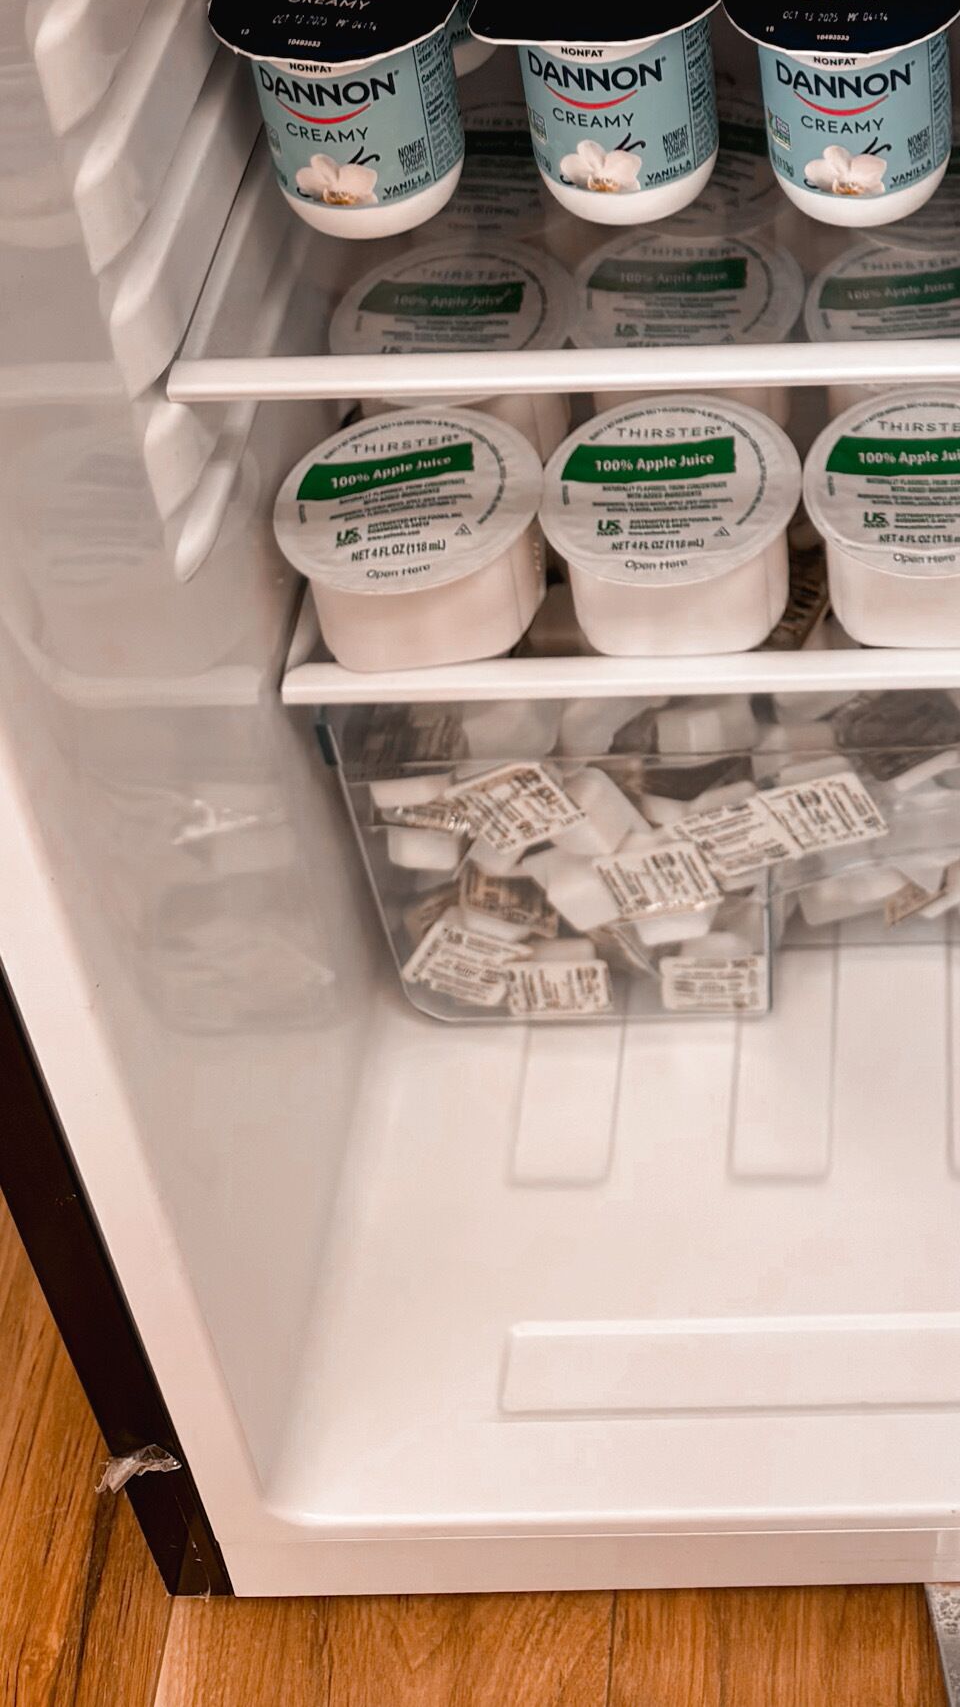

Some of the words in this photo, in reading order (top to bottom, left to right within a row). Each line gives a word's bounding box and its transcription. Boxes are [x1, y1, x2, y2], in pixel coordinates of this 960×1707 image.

[782, 10, 799, 20] OCT
[561, 46, 604, 57] NONFAT
[289, 62, 332, 73] NONFAT
[527, 49, 664, 93] DANNON
[813, 56, 857, 67] NONFAT
[259, 65, 397, 107] DANNON
[775, 59, 911, 99] DANNON
[552, 107, 635, 128] CREAMY
[801, 115, 884, 135] CREAMY
[286, 122, 369, 143] CREAMY
[662, 123, 689, 145] NONFAT
[646, 158, 692, 182] VANILLA
[890, 157, 933, 184] VANILLA
[384, 171, 431, 196] VANILLA
[617, 426, 717, 438] THIRSTER
[352, 434, 454, 455] THIRSTER
[595, 458, 633, 472] 100%
[636, 457, 676, 473] Apple
[679, 452, 714, 466] Juice
[857, 451, 896, 464] 100%
[900, 451, 939, 466] Apple
[330, 471, 371, 490] 100%
[373, 462, 413, 482] Apple
[416, 455, 452, 470] Juice
[863, 512, 887, 524] US
[611, 539, 630, 551] NET
[879, 533, 897, 543] NET
[899, 533, 905, 542] 4
[906, 533, 916, 543] FL
[919, 533, 931, 543] OZ
[351, 549, 370, 562] NET
[372, 548, 378, 558] 4
[379, 546, 390, 557] FL
[392, 543, 405, 556] OZ
[926, 553, 956, 564] Here
[366, 568, 398, 580] Open
[402, 564, 430, 576] Here
[625, 559, 656, 571] Open
[659, 559, 688, 570] Here
